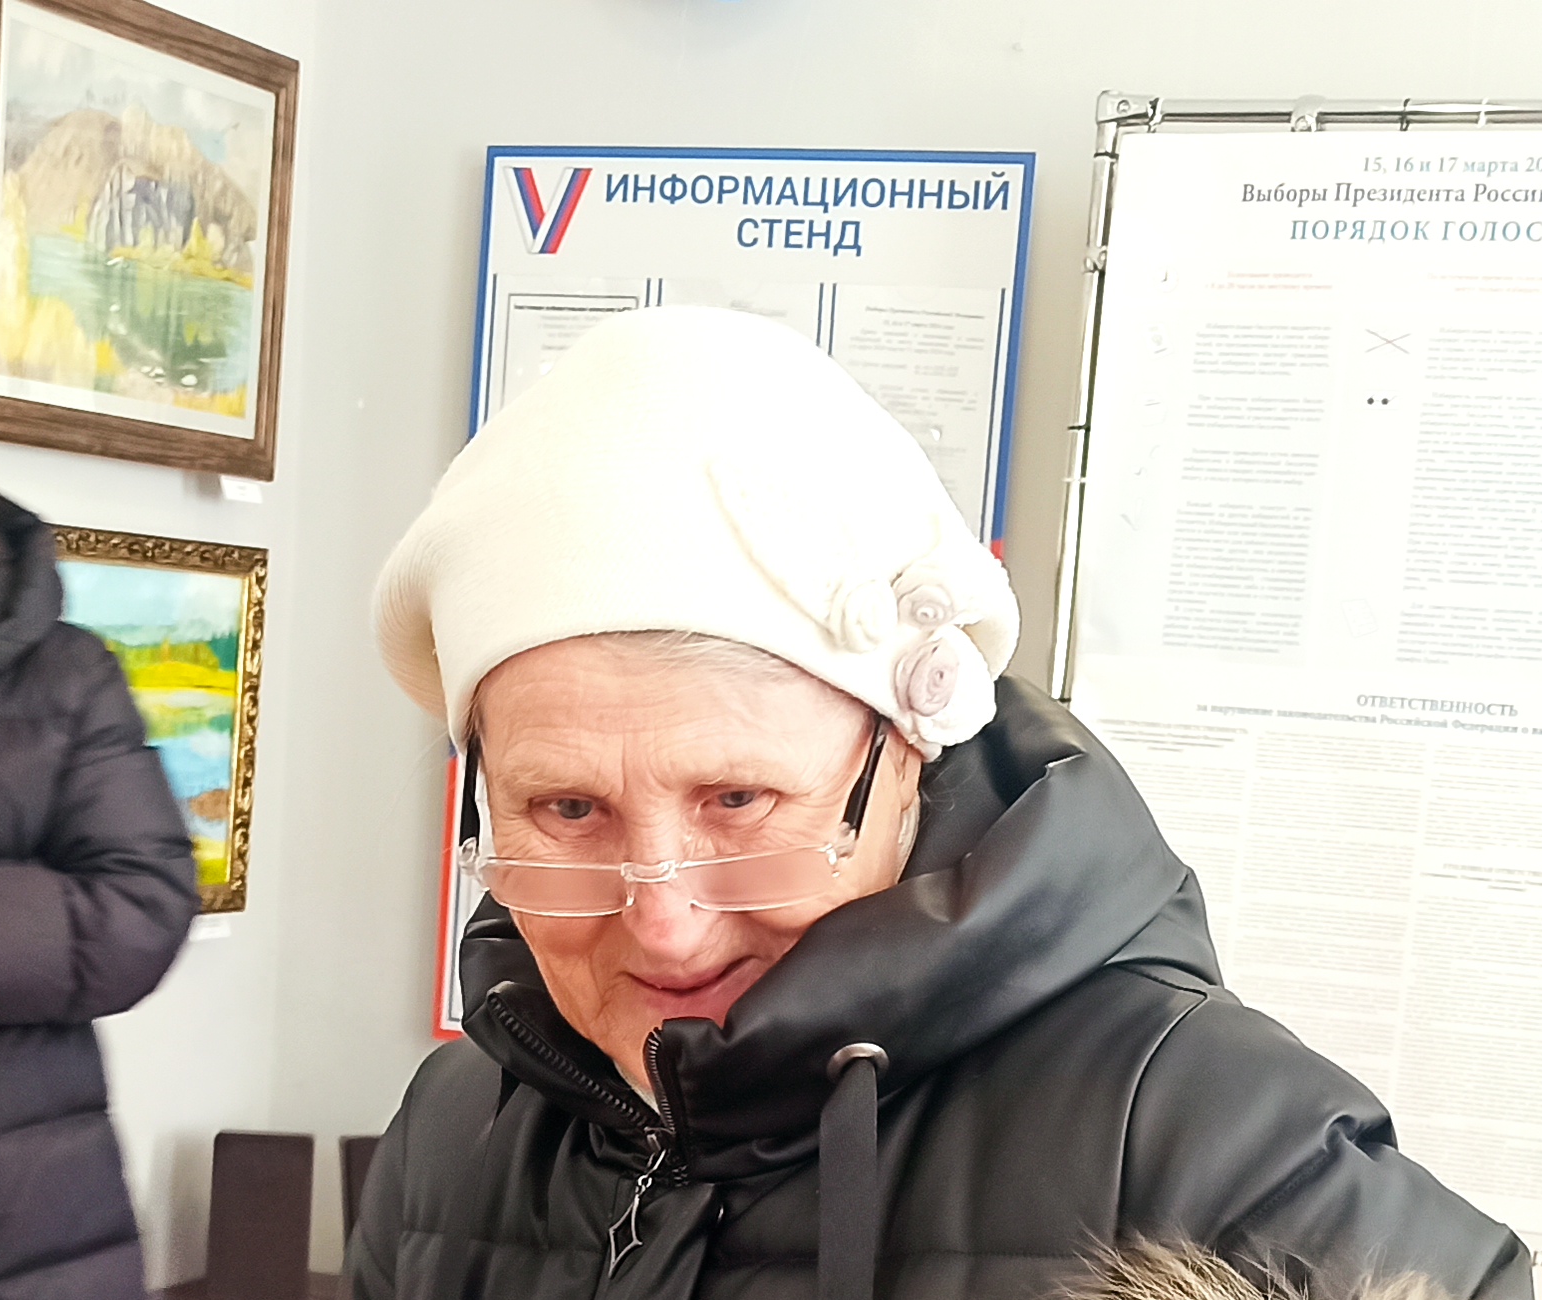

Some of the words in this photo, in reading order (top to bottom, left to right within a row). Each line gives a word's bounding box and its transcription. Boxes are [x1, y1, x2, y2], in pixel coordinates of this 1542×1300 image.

[1362, 156, 1388, 174] 15,
[1395, 156, 1415, 173] 16
[1419, 160, 1432, 173] и
[1438, 156, 1459, 173] 17
[1462, 160, 1520, 177] марта
[604, 171, 1011, 213] ИНФОРМАЦИОННЫЙ
[1241, 182, 1328, 207] Выборы
[1334, 182, 1466, 207] Президента
[736, 217, 863, 257] СТЕНД
[1289, 219, 1431, 245] ПОРЯДОК
[1356, 694, 1518, 717] ОТВЕТСТВЕННОСТЬ
